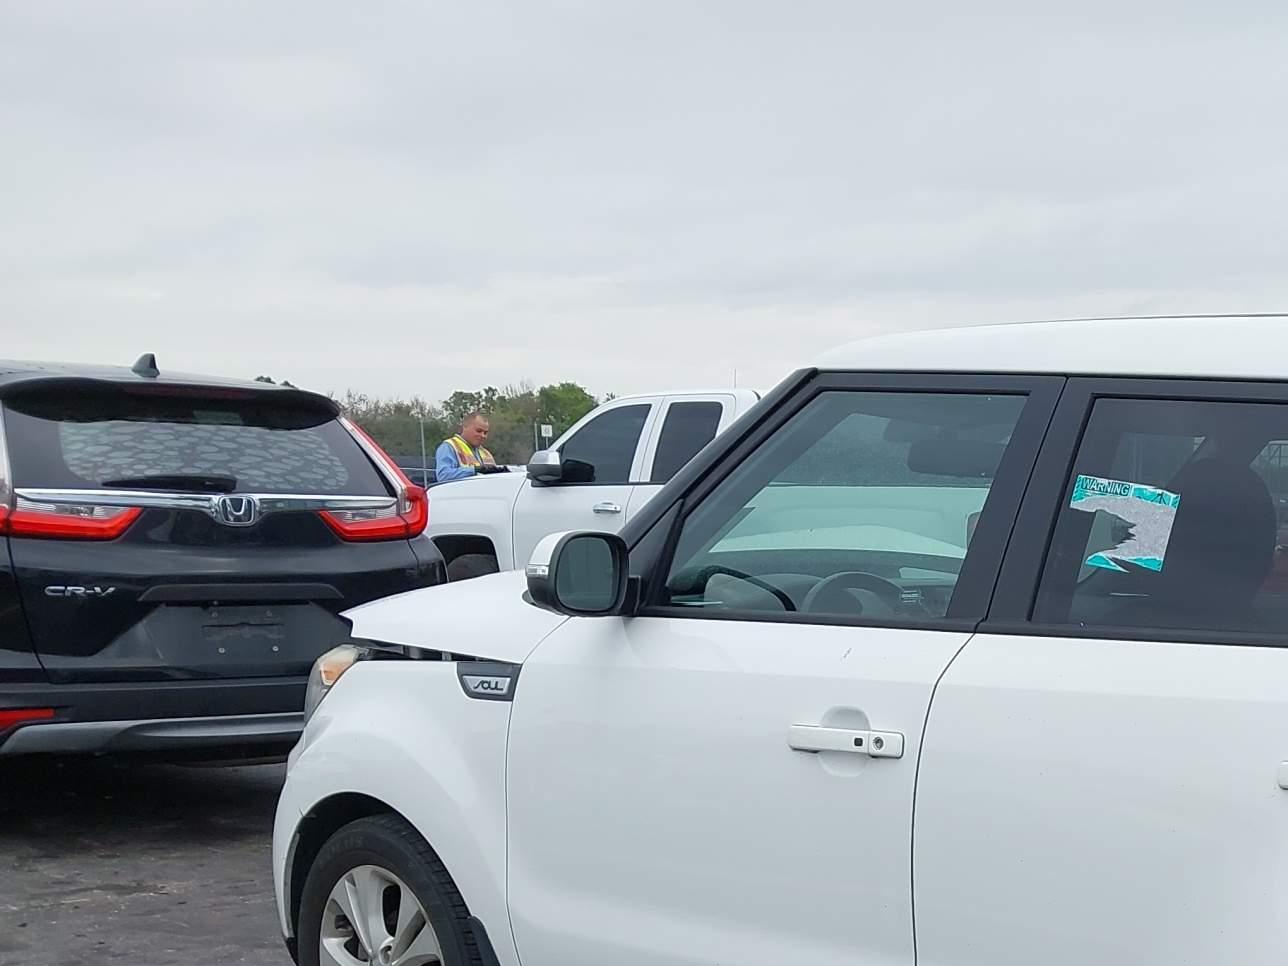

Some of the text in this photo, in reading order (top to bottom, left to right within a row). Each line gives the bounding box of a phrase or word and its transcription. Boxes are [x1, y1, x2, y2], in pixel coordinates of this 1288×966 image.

[1082, 478, 1131, 496] WARNING
[44, 586, 116, 597] CR-V
[473, 680, 504, 691] SOUL
